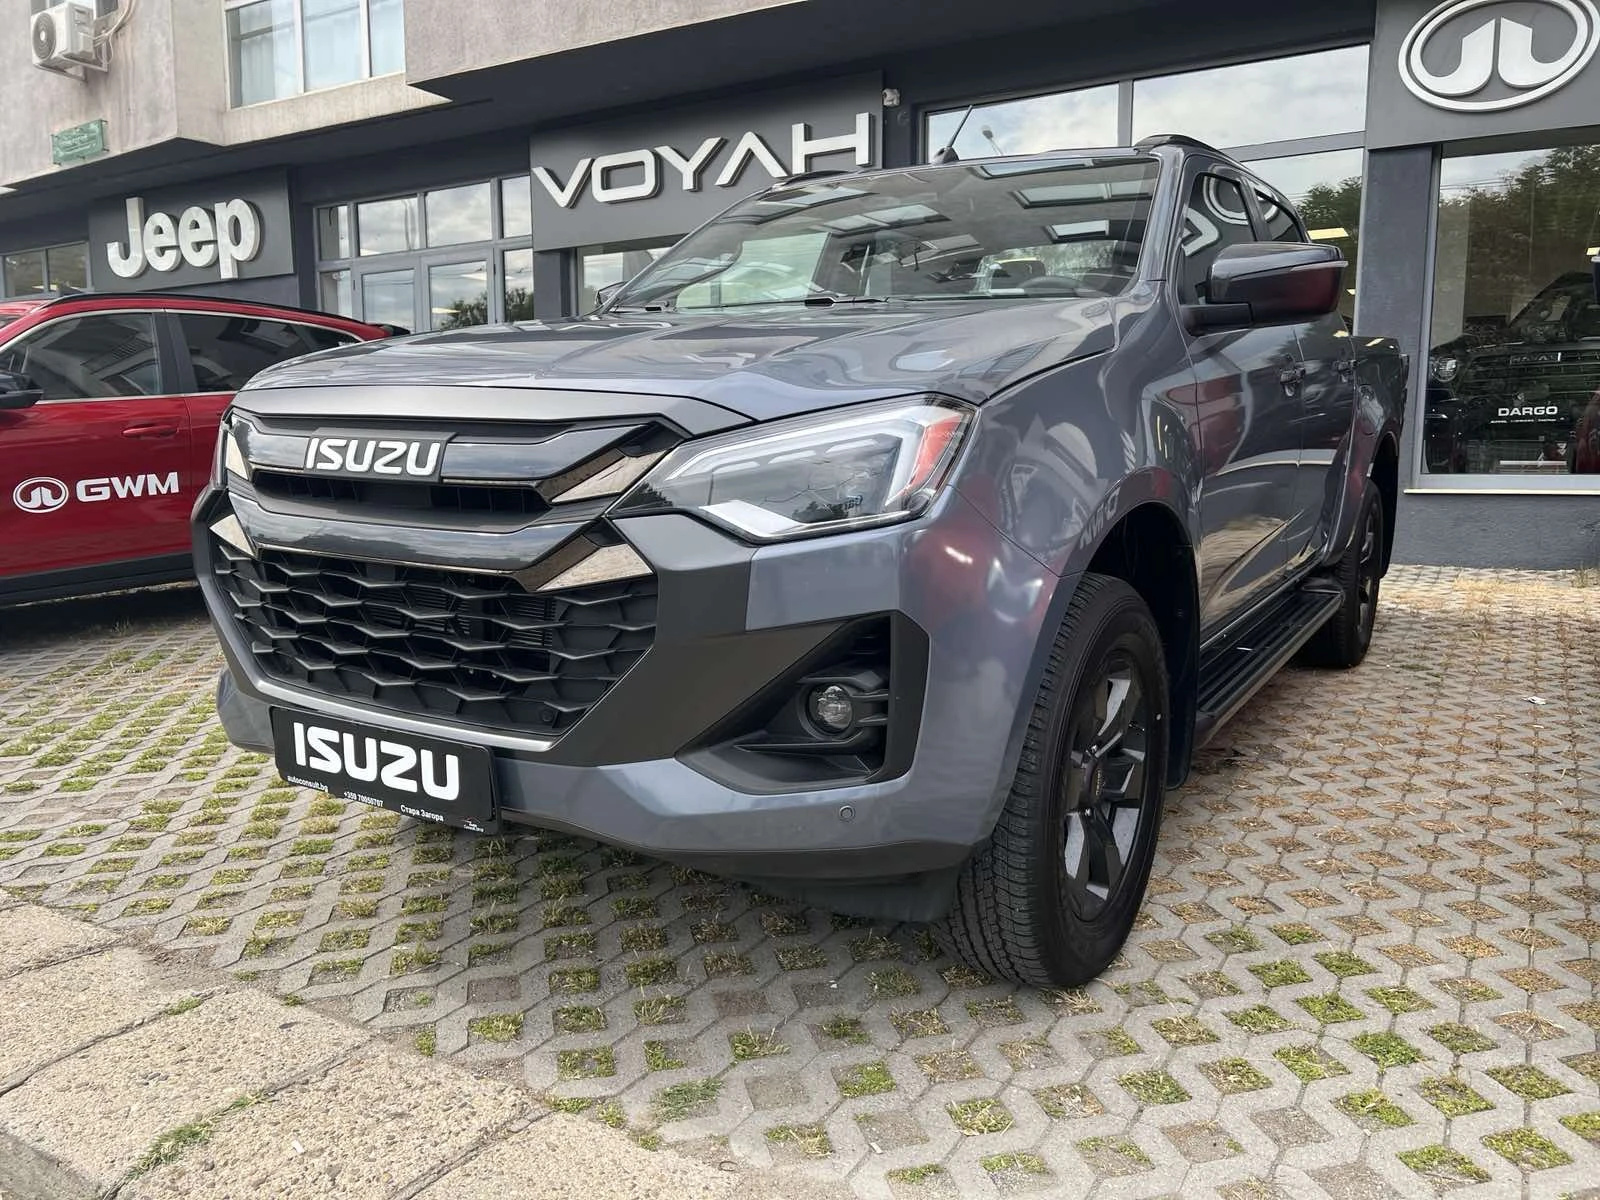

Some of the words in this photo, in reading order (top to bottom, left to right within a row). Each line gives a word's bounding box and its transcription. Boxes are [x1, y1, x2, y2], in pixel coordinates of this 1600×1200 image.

[532, 112, 872, 208] VOYAH
[107, 196, 260, 280] Jeep
[1498, 406, 1558, 416] DARGO
[304, 436, 442, 477] ISUZU
[76, 472, 179, 502] GWM
[293, 722, 459, 801] ISUZU
[400, 804, 420, 817] Стара
[420, 809, 444, 822] Загора
